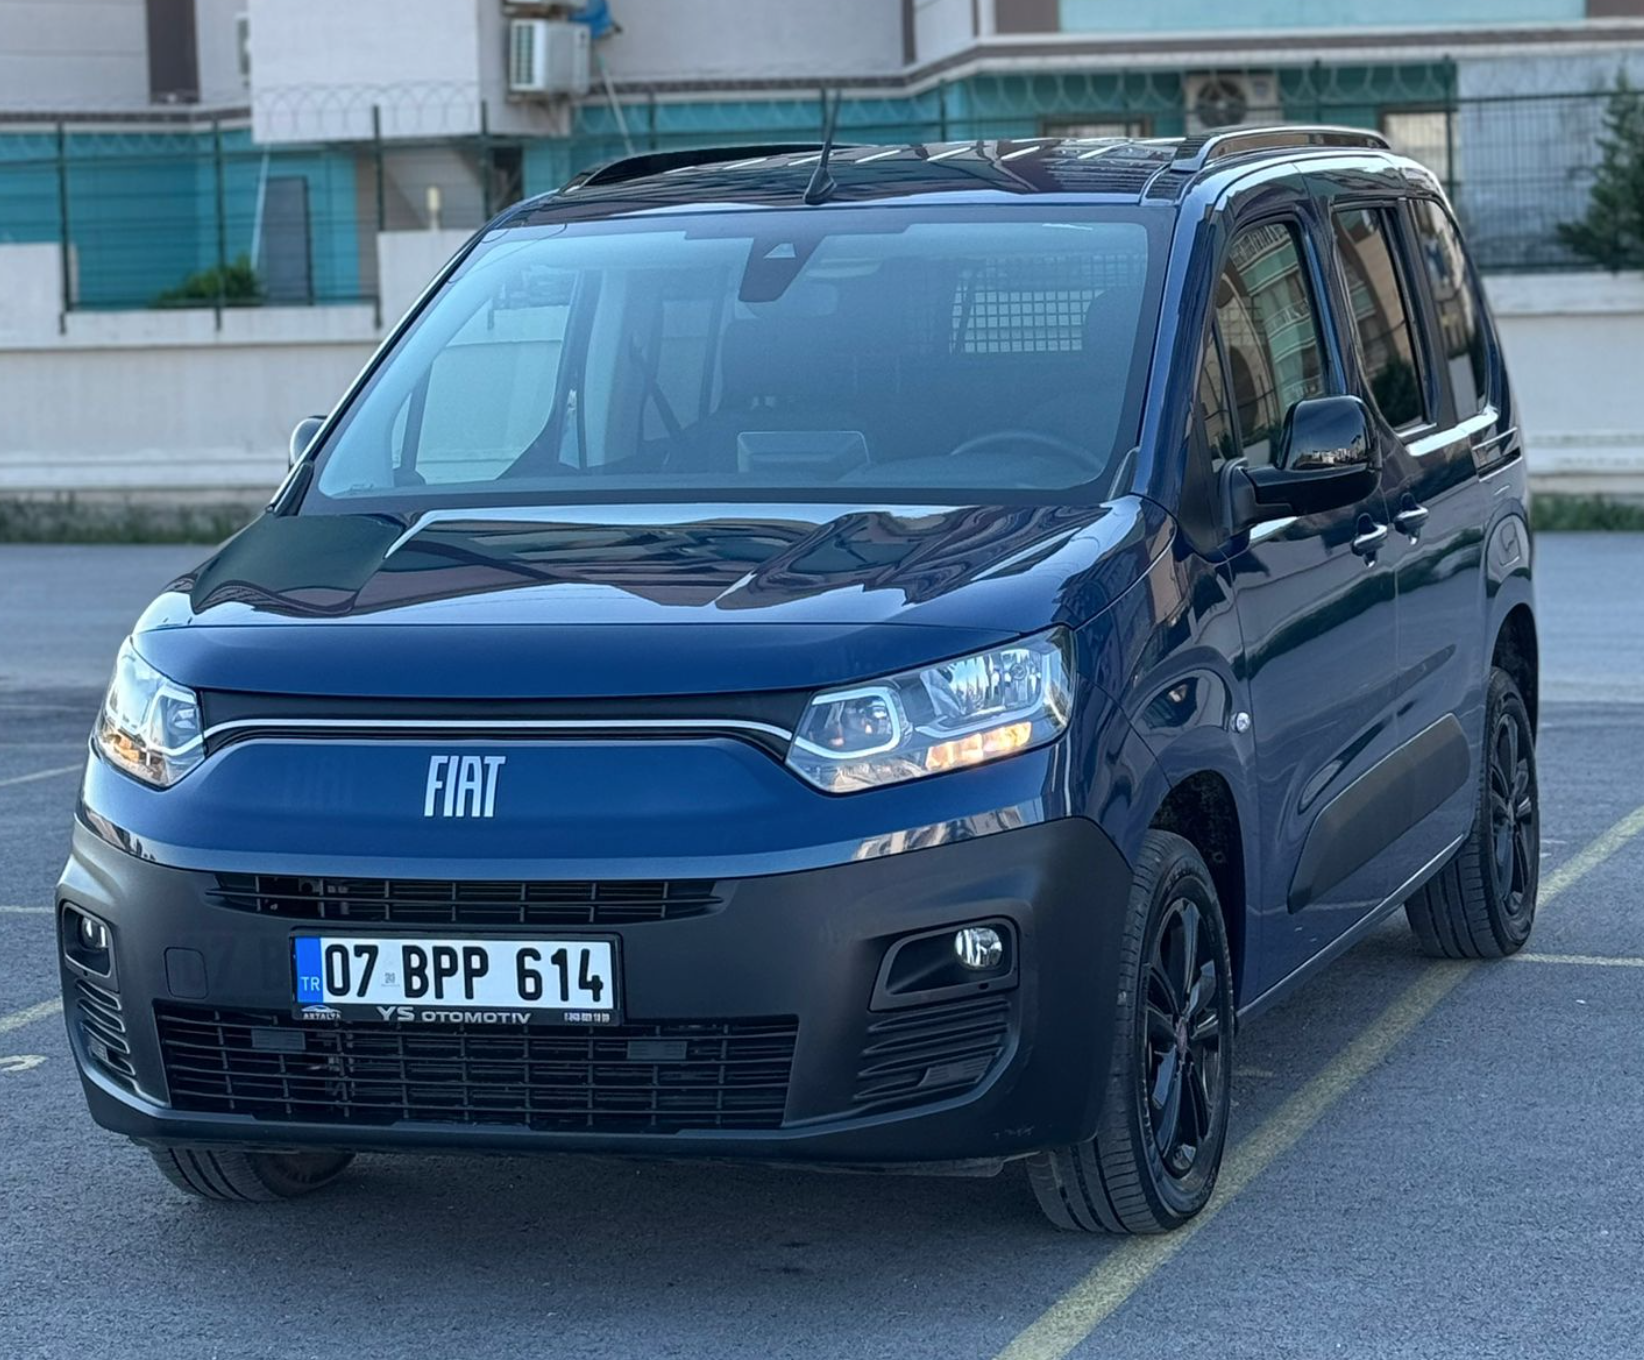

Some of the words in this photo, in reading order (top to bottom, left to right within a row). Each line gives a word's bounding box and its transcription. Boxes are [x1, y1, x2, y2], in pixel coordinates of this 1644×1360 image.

[424, 755, 506, 818] FIAT
[301, 976, 321, 992] TR
[325, 944, 379, 998] 07
[402, 945, 489, 999] BPP
[516, 948, 604, 1002] 614
[376, 1006, 415, 1021] YS
[421, 1011, 531, 1024] OTOMOTIV
